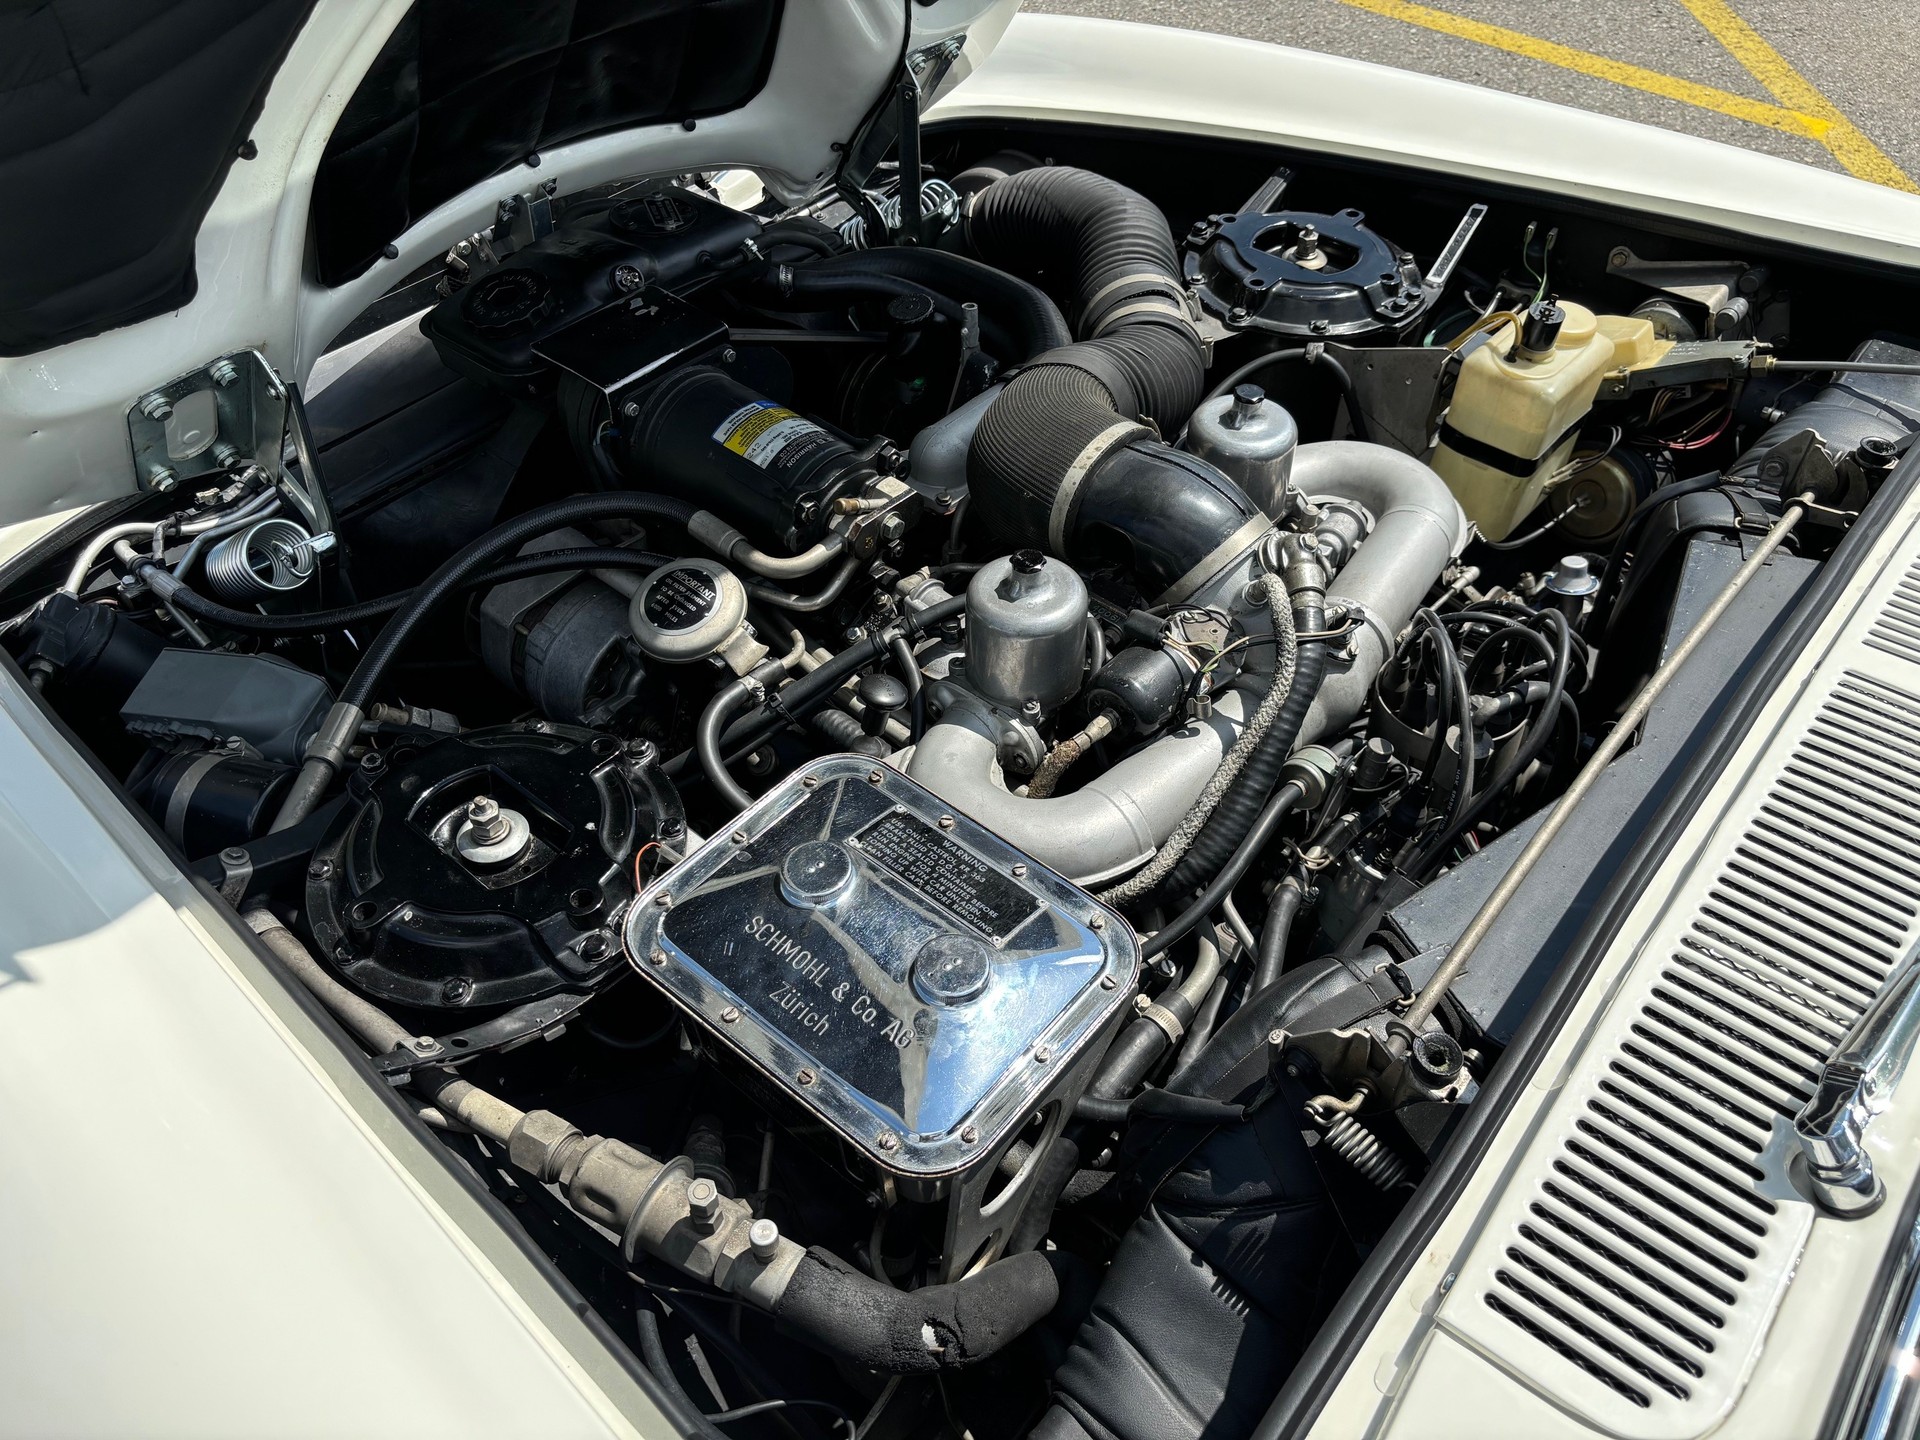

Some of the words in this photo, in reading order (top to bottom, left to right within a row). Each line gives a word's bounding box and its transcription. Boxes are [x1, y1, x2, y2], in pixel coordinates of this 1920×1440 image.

[786, 442, 817, 468] HARRISON
[672, 582, 686, 592] FILTER
[686, 590, 706, 606] ELEMENT
[673, 570, 716, 598] IMPORTANT
[656, 594, 670, 604] AFTER
[672, 604, 686, 616] EVERY
[665, 612, 678, 623] MILES
[674, 594, 696, 612] CHANGED
[878, 827, 900, 842] FROM
[908, 847, 934, 866] SEALED
[884, 823, 908, 840] BRAKE
[907, 838, 927, 852] FLUID
[928, 852, 938, 860] TO
[891, 819, 905, 829] USE
[906, 828, 926, 842] ONLY
[959, 864, 970, 873] RR
[971, 871, 986, 883] 363
[942, 840, 988, 872] WARNING
[860, 841, 883, 858] CLEAN
[883, 856, 904, 873] FILLER
[905, 872, 924, 886] CAPS
[924, 885, 952, 905] BEFORE
[867, 836, 898, 858] TOPPING
[910, 865, 930, 881] WITH
[930, 880, 946, 892] CAR
[872, 832, 889, 844] RUN
[889, 843, 916, 862] ENGINE
[916, 861, 932, 873] FOR
[939, 877, 971, 900] MINUTES
[971, 899, 999, 919] BEFORE
[745, 915, 830, 988] SCHMOHL
[832, 982, 850, 1003] &
[851, 995, 878, 1027] Co.
[880, 1019, 915, 1050] AG
[769, 980, 830, 1036] Zürich
